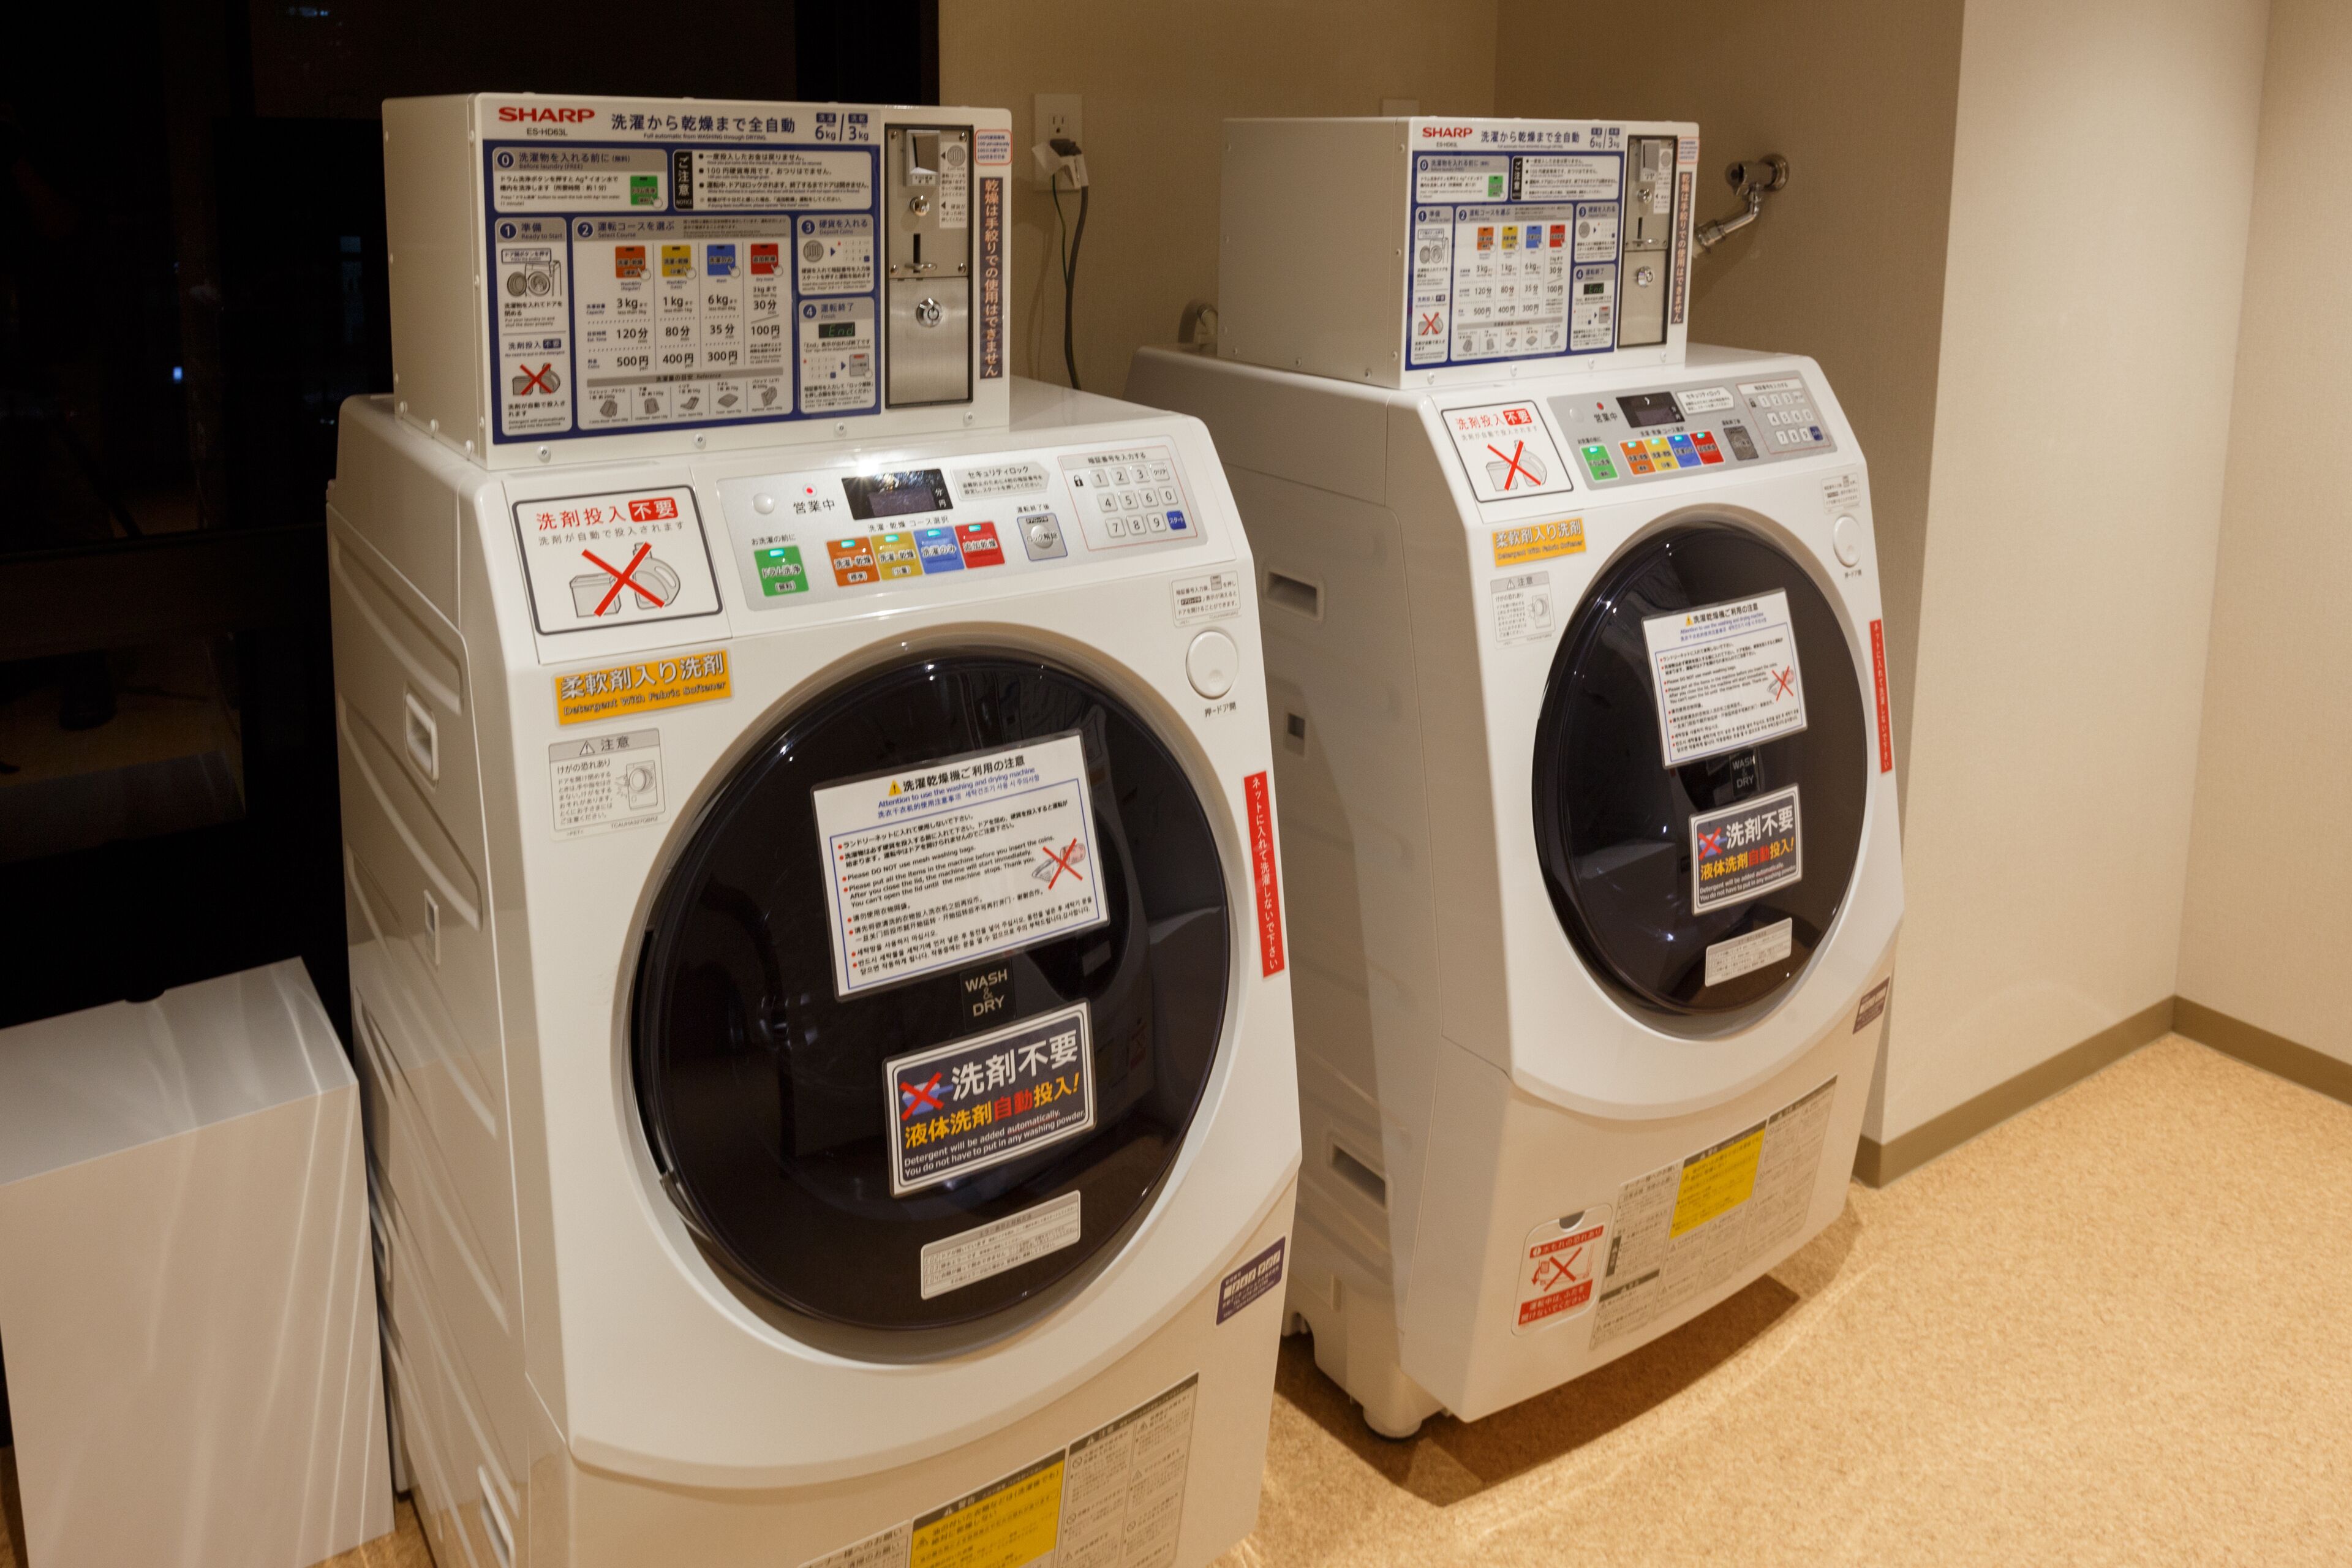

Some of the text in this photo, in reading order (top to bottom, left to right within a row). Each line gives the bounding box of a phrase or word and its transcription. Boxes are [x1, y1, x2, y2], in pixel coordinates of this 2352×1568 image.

[499, 107, 595, 123] SHARP
[611, 113, 795, 133] 洗濯から乾燥まで全自動
[1422, 127, 1472, 138] SHARP
[1481, 130, 1580, 143] 洗濯から乾燥まで全自動
[519, 153, 609, 162] 洗濯物を入れる前に
[521, 223, 541, 232] 準備
[598, 221, 674, 232] 運転コースを選ぶ
[985, 179, 999, 377] 乾燥は手絞りでの使用はできません
[1589, 285, 1603, 293] End
[821, 303, 854, 312] 運転終了
[829, 324, 854, 336] End
[508, 341, 541, 350] 洗剤投入
[1456, 410, 1531, 431] 洗剤投入 不要
[1594, 412, 1618, 423] 営業中
[1088, 452, 1146, 464] 暗証番号を入力する
[968, 466, 1028, 478] セキュリティロック
[1096, 475, 1102, 483] 1
[1117, 472, 1124, 481] 2
[1137, 469, 1144, 479] 3
[794, 499, 835, 514] 営業中
[1104, 492, 1172, 507] 4 5 6 0
[537, 499, 674, 531] 洗剤投入 不要
[910, 516, 949, 527] コース選択
[1113, 518, 1160, 532] 7 8 9
[538, 521, 684, 546] 洗剤が自動で投入されます
[751, 533, 796, 546] お洗濯の前に
[1496, 519, 1581, 549] 柔軟剤入り洗剤
[921, 545, 956, 557] 洗濯のみ
[963, 538, 998, 551] 追加乾燥
[762, 564, 801, 579] ドラム洗浄
[1518, 576, 1533, 587] 注意
[1694, 603, 1758, 624] 洗濯乾燥機ご利用の注意
[562, 652, 724, 701] 柔軟剤入り洗剤
[564, 682, 726, 716] Detergent With Fabric Softener
[601, 736, 630, 752] 注意
[557, 759, 610, 775] けがの恐れあり
[1732, 755, 1755, 771] WASH
[903, 755, 1025, 792] 洗濯乾燥機ご利用の注意
[878, 797, 910, 808] Attention
[946, 781, 976, 795] washing
[988, 774, 1008, 783] drying
[1009, 767, 1035, 778] machine
[1737, 775, 1754, 789] DRY
[1727, 805, 1793, 850] 洗剤不要
[848, 871, 869, 881] Please
[884, 864, 897, 872] NOT
[913, 856, 930, 865] mesh
[932, 849, 958, 861] washing
[959, 846, 976, 854] bags.
[849, 882, 871, 891] Please
[873, 878, 884, 888] put
[908, 869, 926, 878] items
[948, 857, 974, 867] machine
[1009, 843, 1026, 851] insert
[1252, 777, 1278, 970] ネットに入れて洗濯しないで下さい
[1700, 882, 1724, 894] Detergent
[1741, 872, 1755, 882] added
[965, 969, 1008, 993] WASH
[973, 995, 1005, 1017] DRY
[952, 1030, 1078, 1101] 洗剤不要
[904, 1109, 1061, 1167] Detergent will be added automatically.
[905, 1110, 1085, 1178] You do not have to put in any washing powder.
